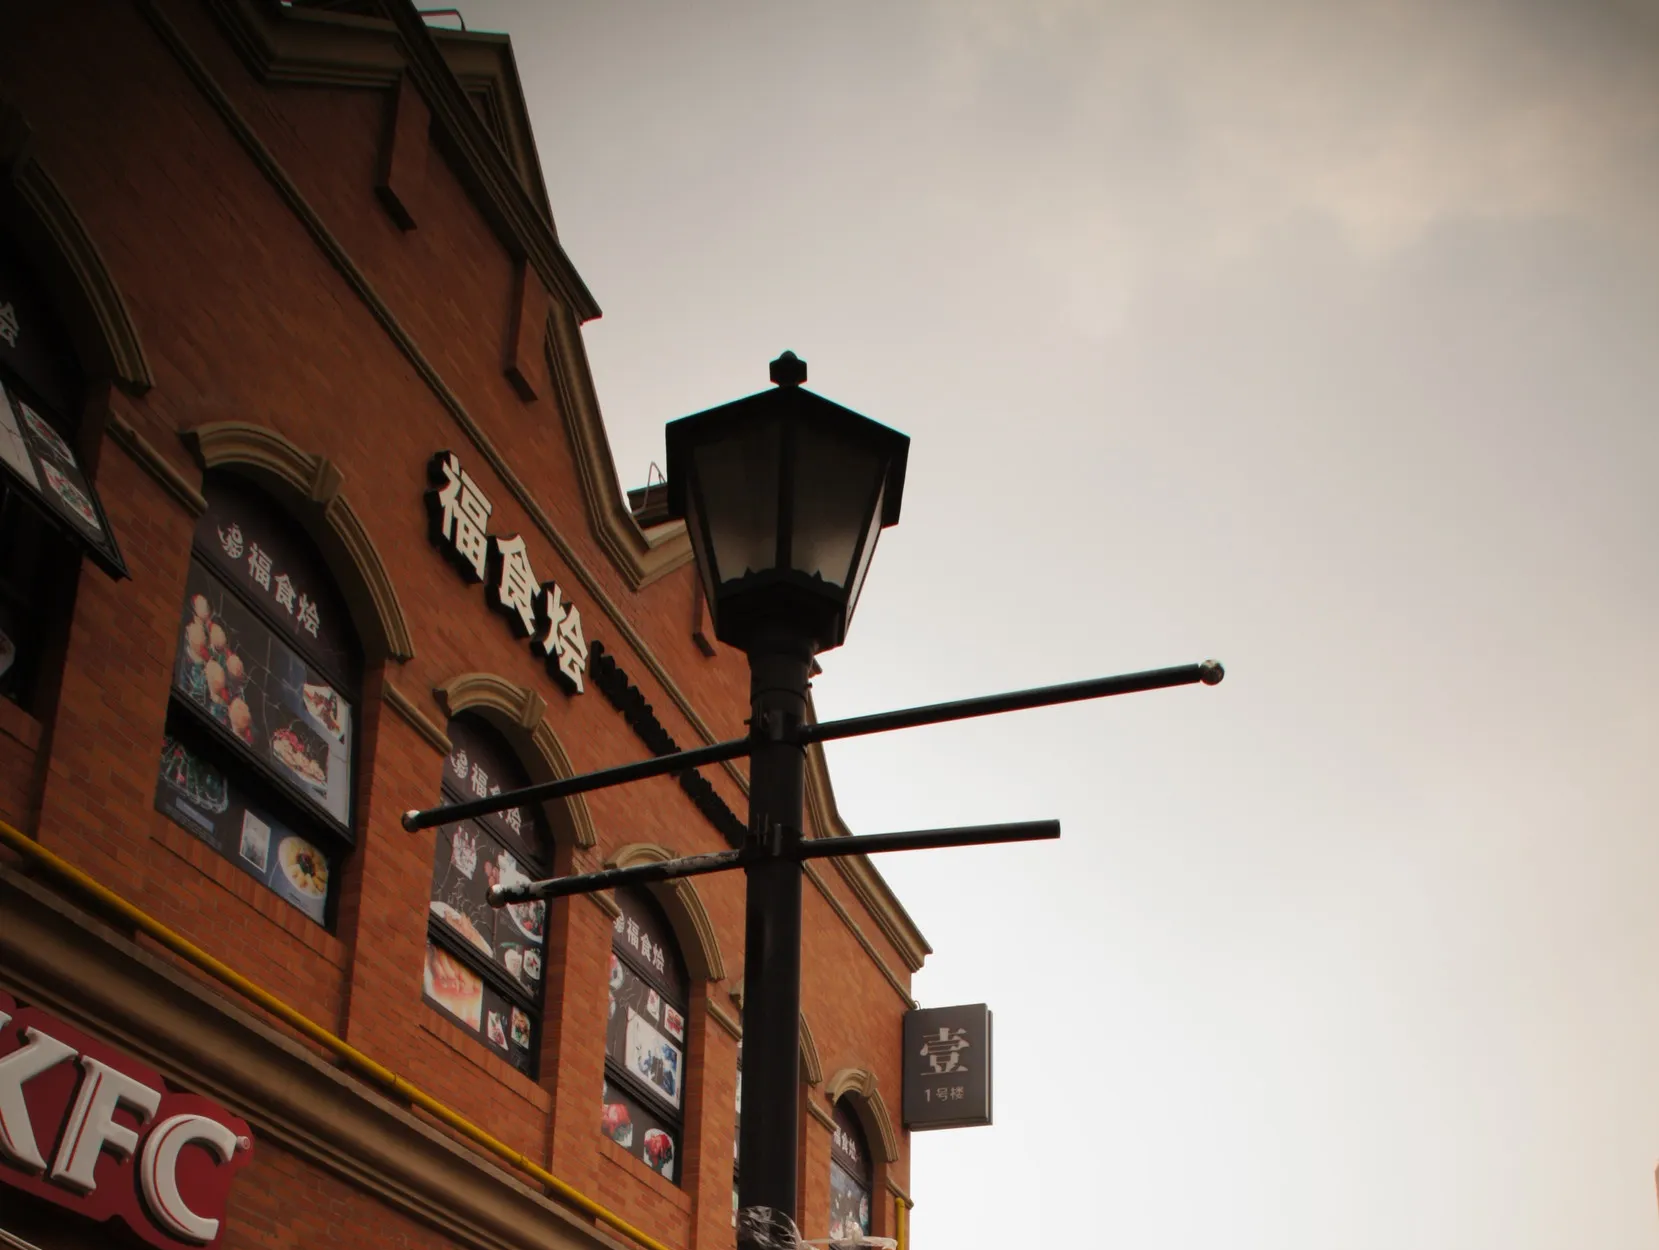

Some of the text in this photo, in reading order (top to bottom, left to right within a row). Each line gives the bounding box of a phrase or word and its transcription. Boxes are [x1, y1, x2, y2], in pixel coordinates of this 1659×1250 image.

[247, 541, 321, 639] 福食烩
[438, 452, 588, 693] 福食烩
[626, 916, 665, 975] 福食烩
[919, 1027, 970, 1076] 壹
[0, 1010, 238, 1241] KFC
[923, 1086, 965, 1103] 1号楼
